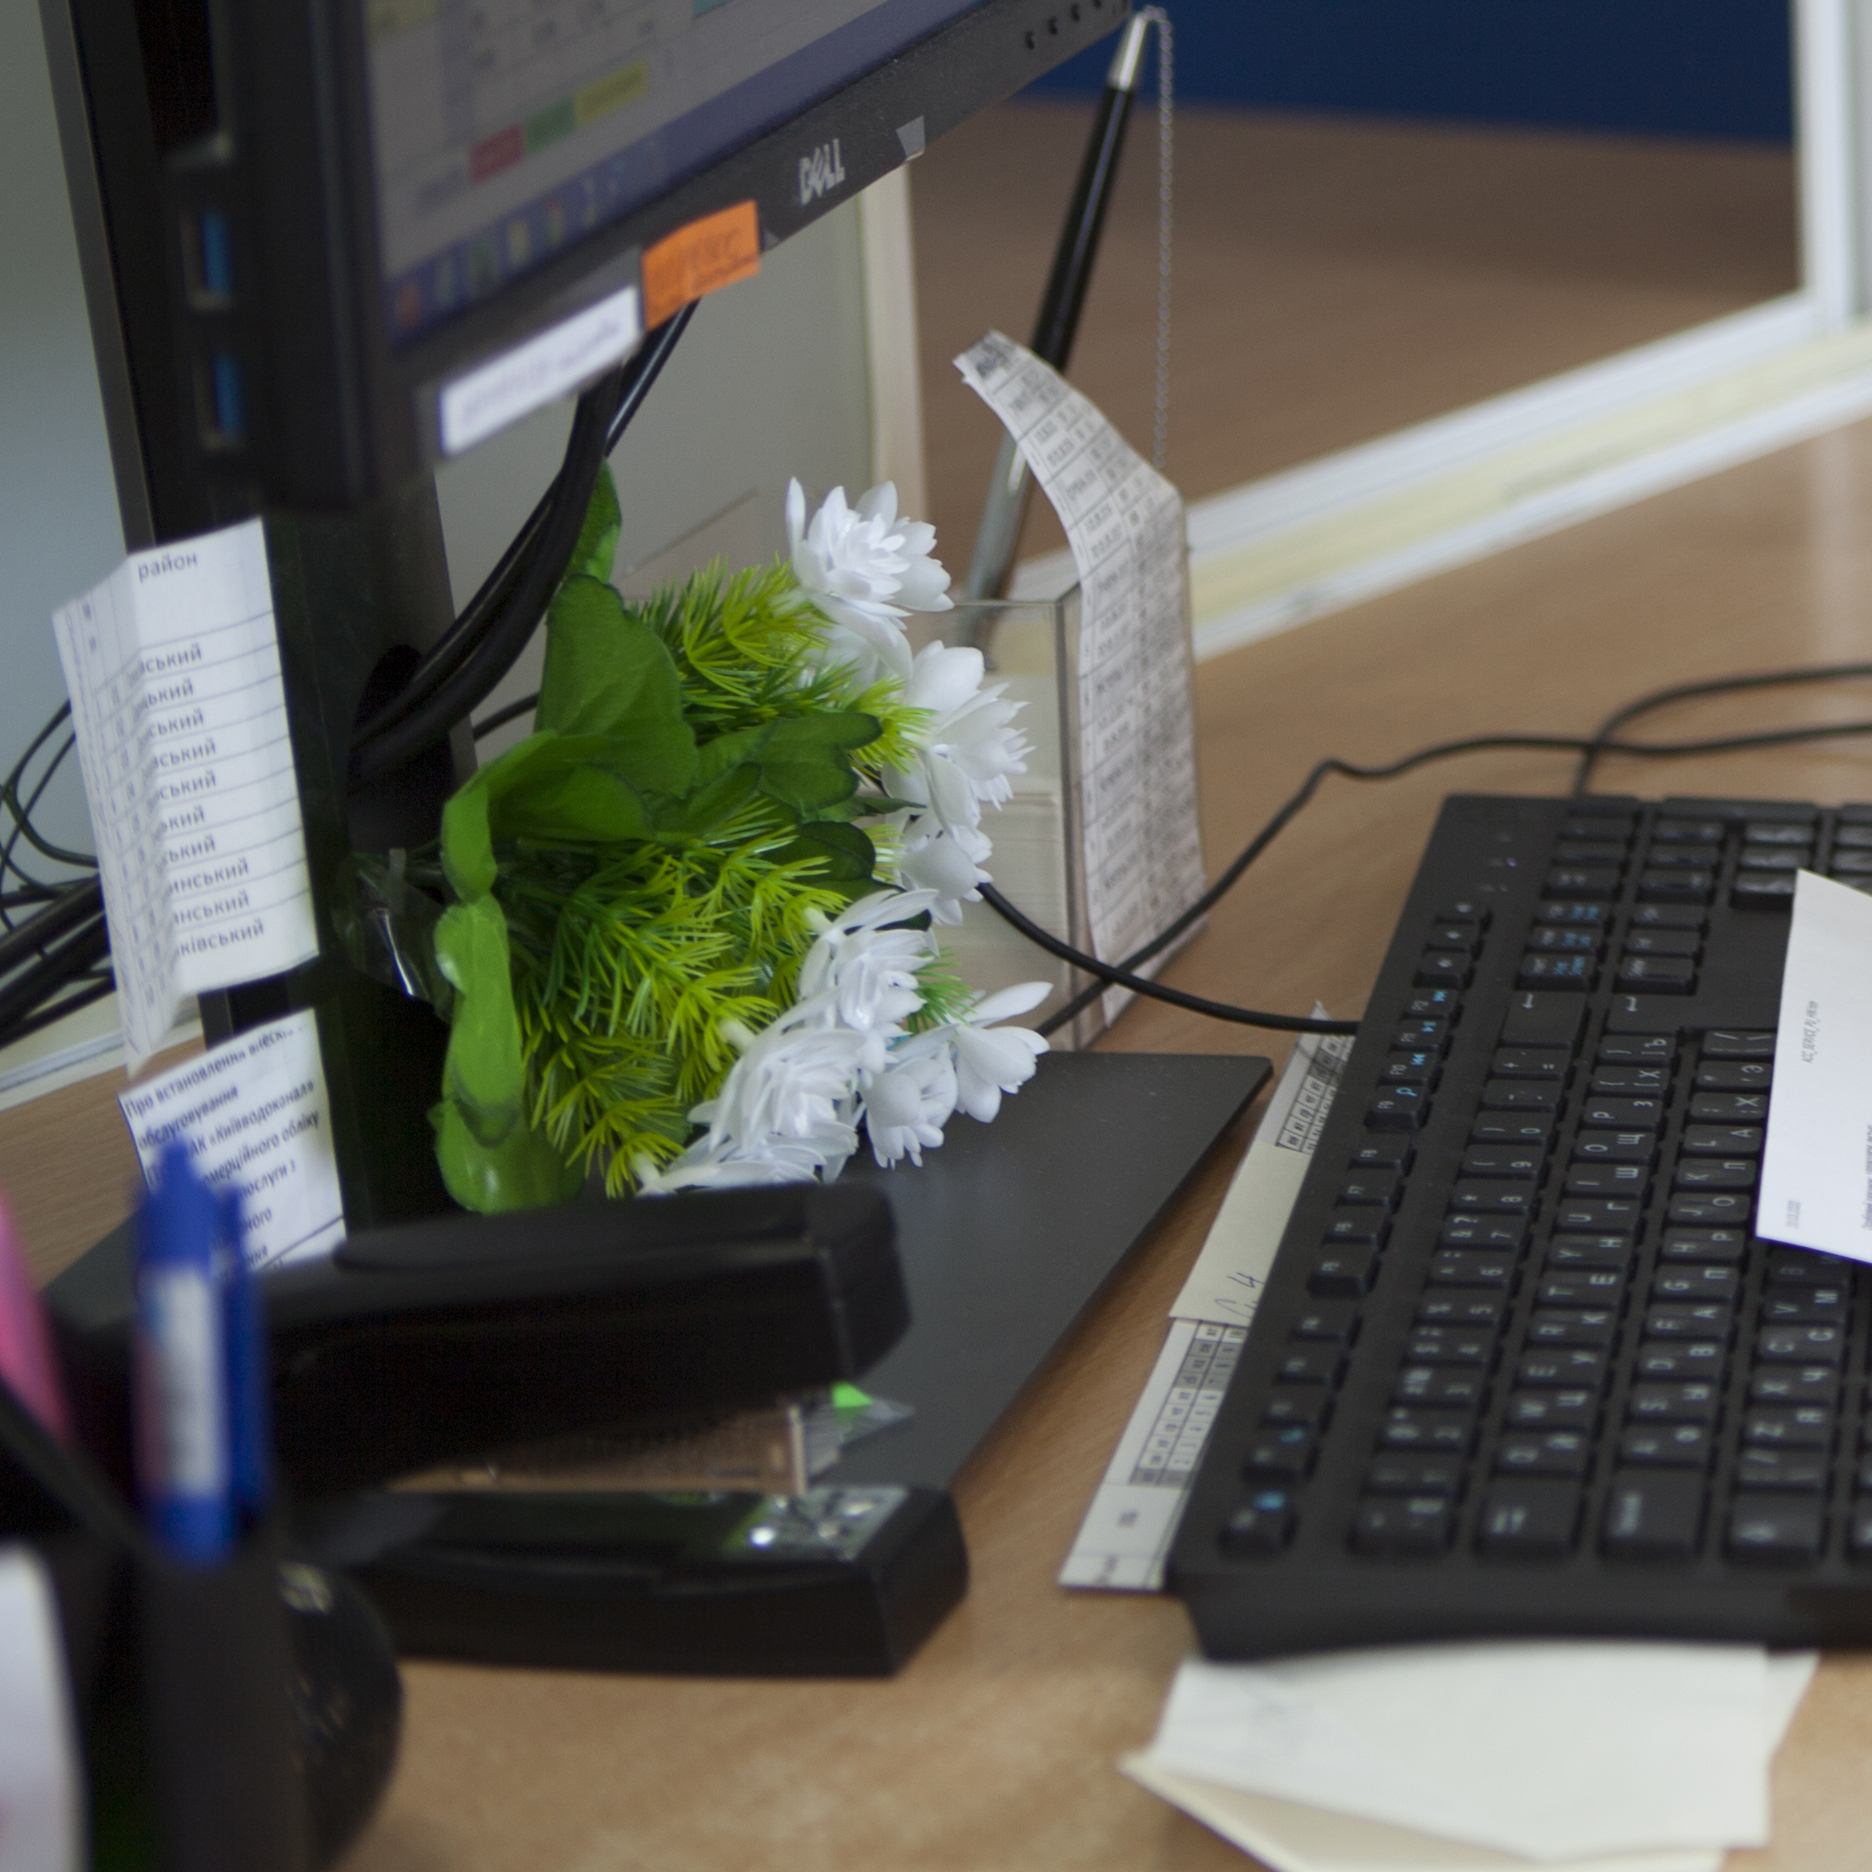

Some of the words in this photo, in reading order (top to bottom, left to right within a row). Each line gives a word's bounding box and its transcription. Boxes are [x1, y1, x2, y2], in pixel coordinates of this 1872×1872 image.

[799, 137, 846, 205] DELL
[137, 552, 197, 583] район
[124, 1093, 154, 1119] Про
[138, 1086, 239, 1150] обслуговування
